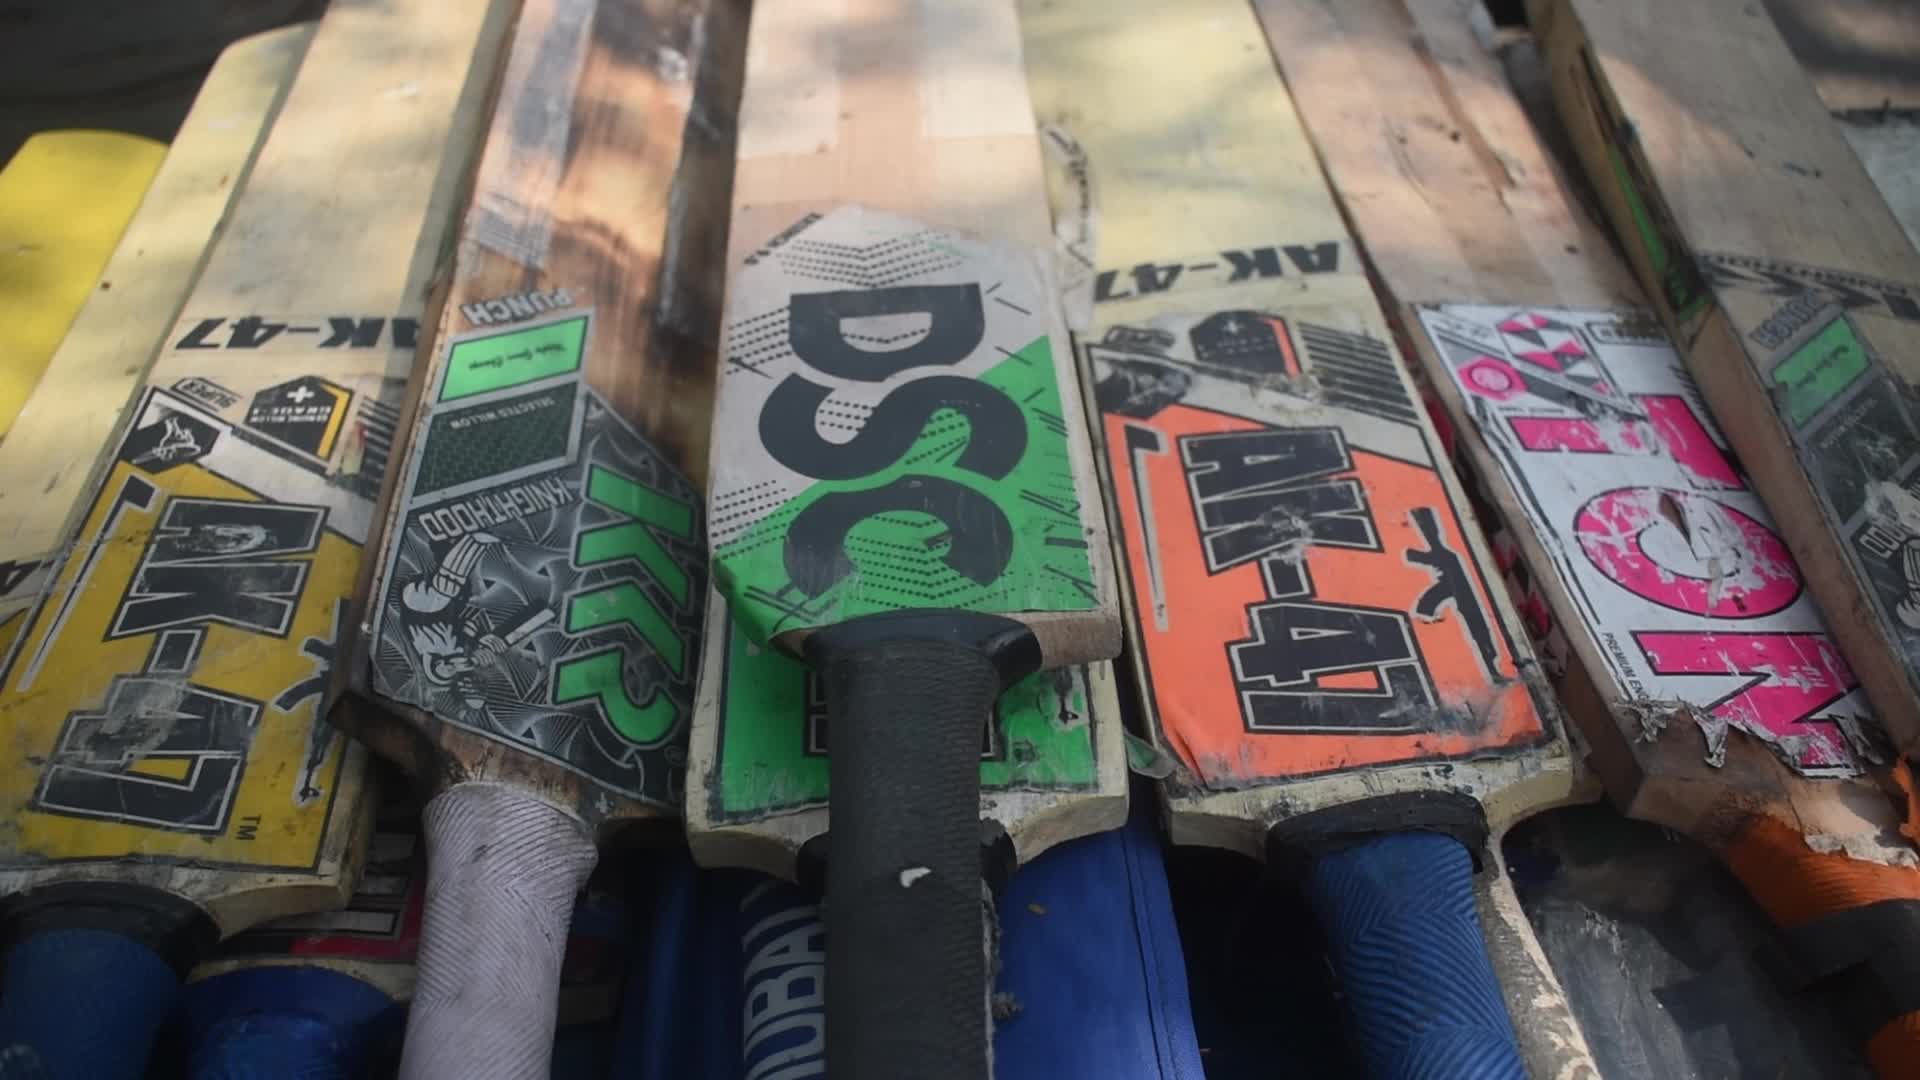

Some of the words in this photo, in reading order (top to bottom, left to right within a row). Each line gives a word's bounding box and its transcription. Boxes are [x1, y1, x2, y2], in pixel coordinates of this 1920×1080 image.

[1094, 241, 1340, 302] AK-47
[462, 287, 573, 326] PUNCH
[450, 409, 497, 430] WILLOW
[758, 282, 1029, 600] DSC
[418, 476, 573, 541] KNIGHTHOOD
[1176, 426, 1438, 736] AK-47
[32, 495, 332, 836] AK-47
[1601, 631, 1637, 678] PREMIUM
[235, 814, 262, 841] TM
